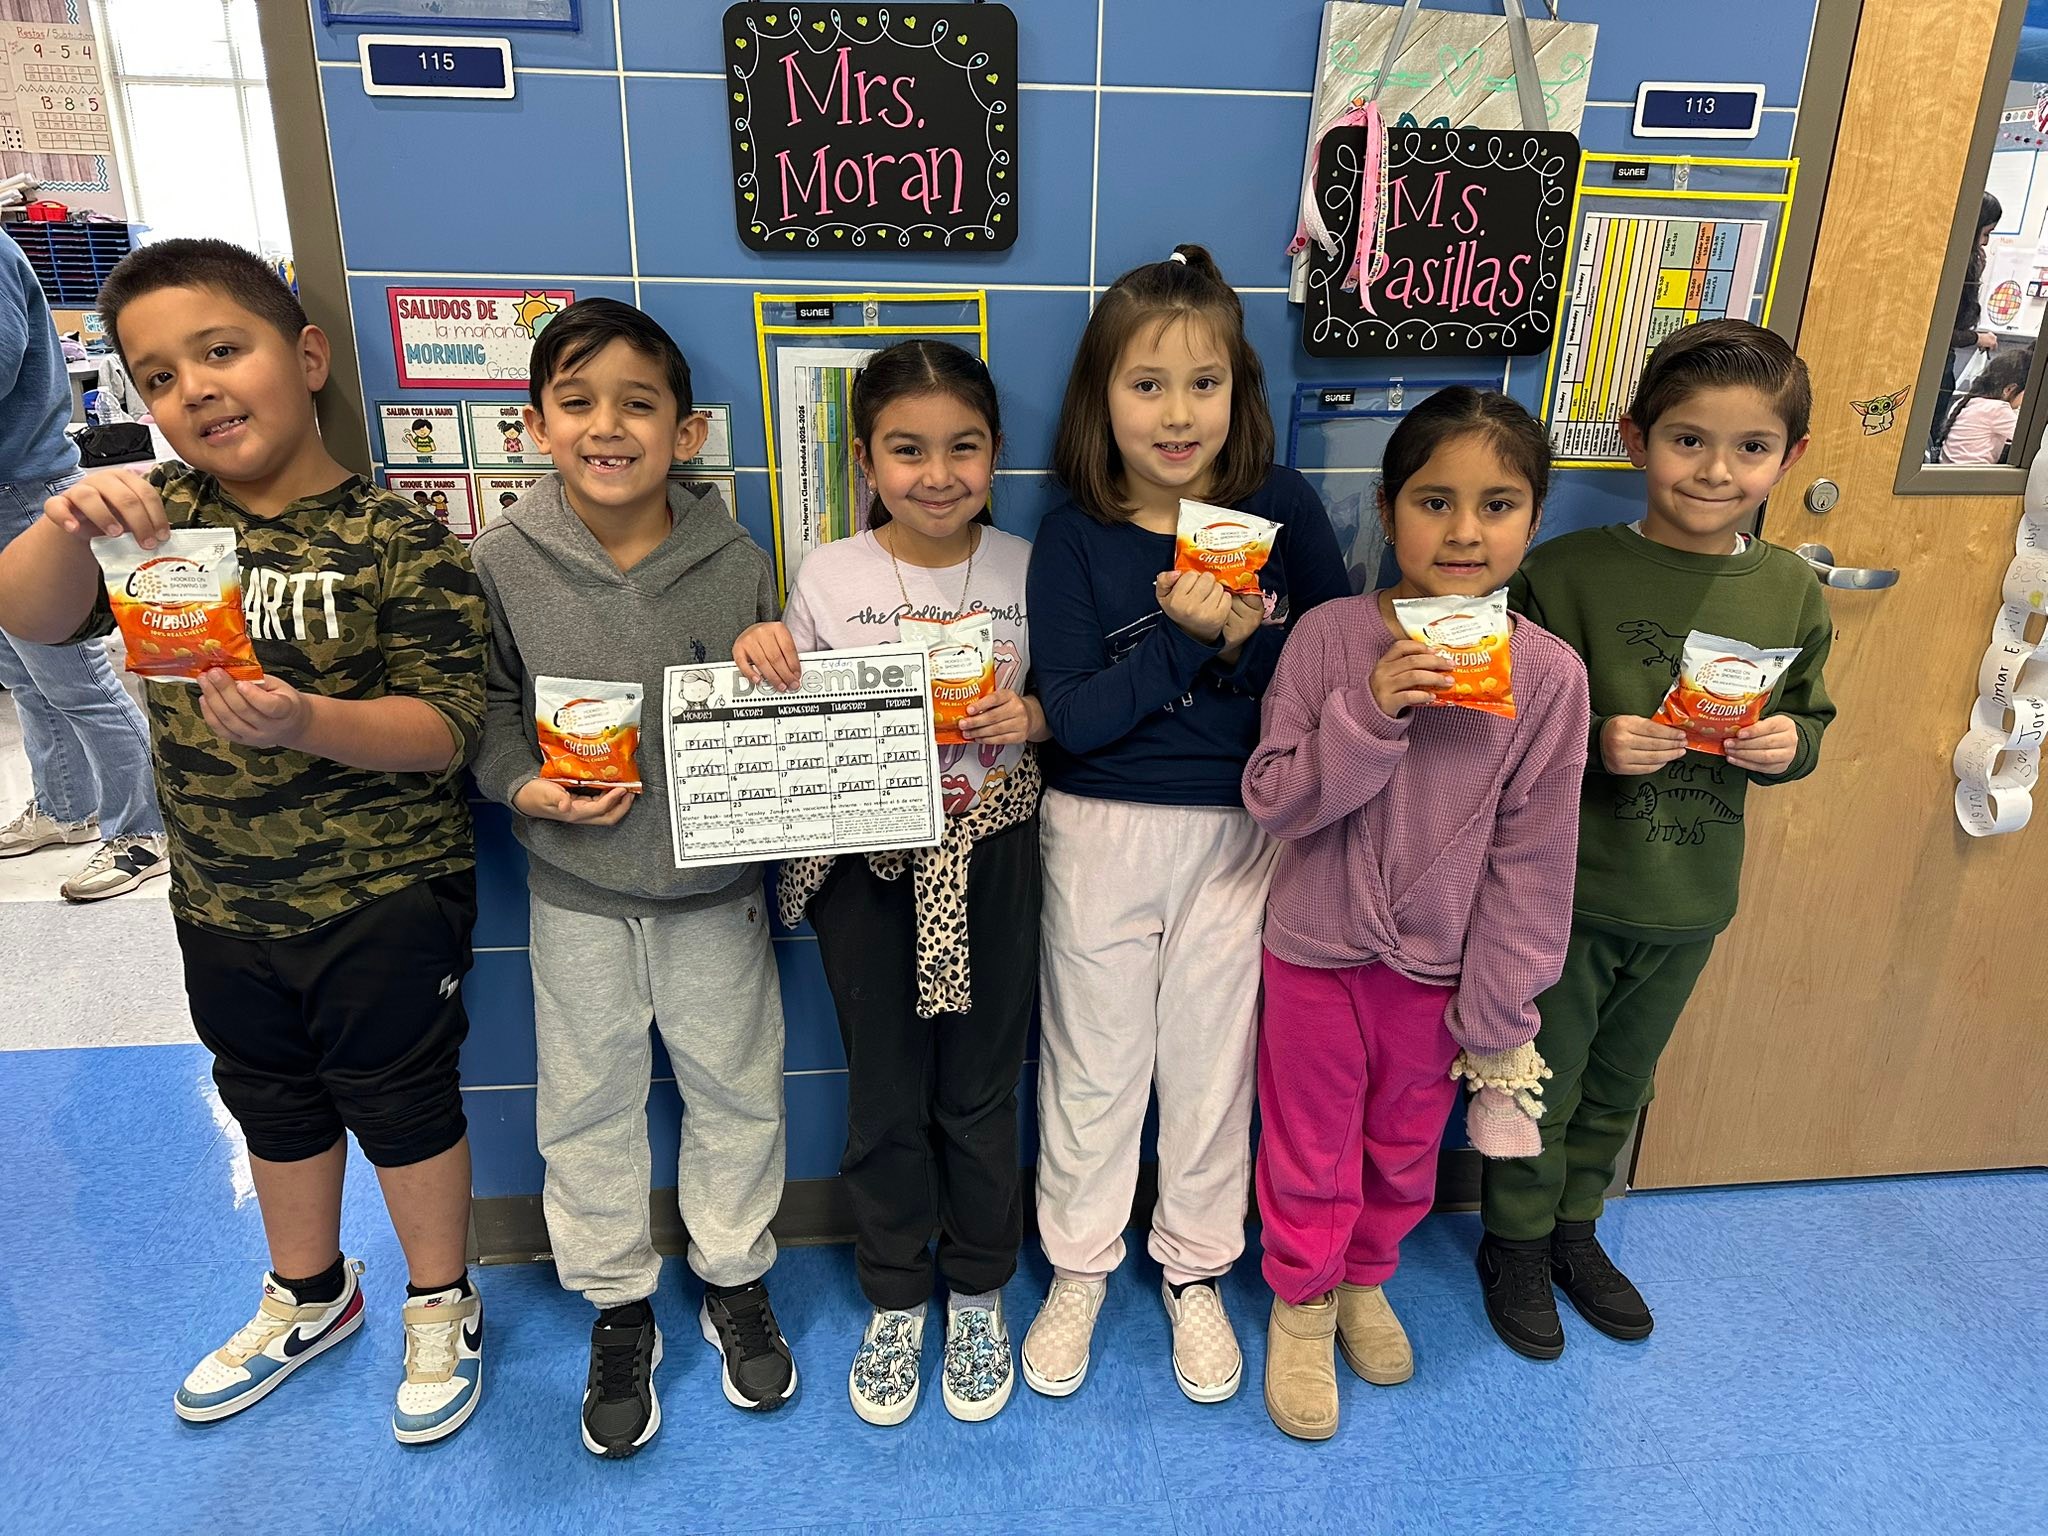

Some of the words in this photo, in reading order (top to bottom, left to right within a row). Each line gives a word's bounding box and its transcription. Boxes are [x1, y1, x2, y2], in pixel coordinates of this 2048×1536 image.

[33, 43, 43, 58] 9
[61, 45, 70, 59] 5
[83, 45, 91, 59] 4
[418, 52, 455, 71] 115
[778, 46, 924, 128] Mrs.
[65, 97, 75, 111] 8
[88, 98, 99, 111] 5
[1685, 97, 1716, 114] 113
[775, 144, 963, 220] Moran
[1387, 170, 1488, 237] Ms.
[1584, 232, 1592, 251] Friday
[1576, 272, 1586, 300] Thursday
[399, 298, 472, 320] SALUDOS
[476, 299, 498, 321] DE
[1587, 286, 1596, 317] Acceleration
[434, 320, 447, 339] la
[454, 322, 526, 340] mañana
[1569, 310, 1579, 342] Wednesday
[405, 343, 487, 365] MORNING
[1564, 352, 1573, 375] Tuesday
[386, 407, 411, 416] SALUDA
[425, 407, 434, 416] LA
[1558, 391, 1567, 413] Monday
[1580, 388, 1588, 420] Foundational
[798, 405, 806, 443] 2025-2026
[400, 480, 424, 488] CHOQUE
[424, 480, 433, 488] DE
[491, 480, 514, 488] CHOQUE
[515, 480, 524, 488] DE
[801, 498, 809, 525] Moran's
[1199, 550, 1247, 564] CHEDDAR
[142, 608, 209, 630] CHEDDAR
[847, 605, 886, 625] the
[732, 661, 921, 698] Deember
[1992, 665, 2009, 706] Omar
[934, 682, 980, 700] CHEDDAR
[683, 712, 712, 720] MONDAY
[733, 708, 763, 718] TUESDAY
[778, 704, 820, 715] WEDNESDAY
[830, 701, 866, 711] THURSDAY
[886, 698, 911, 708] FRIDAY
[1696, 698, 1747, 716] CHEDDAR
[564, 739, 611, 756] CHEDDAR
